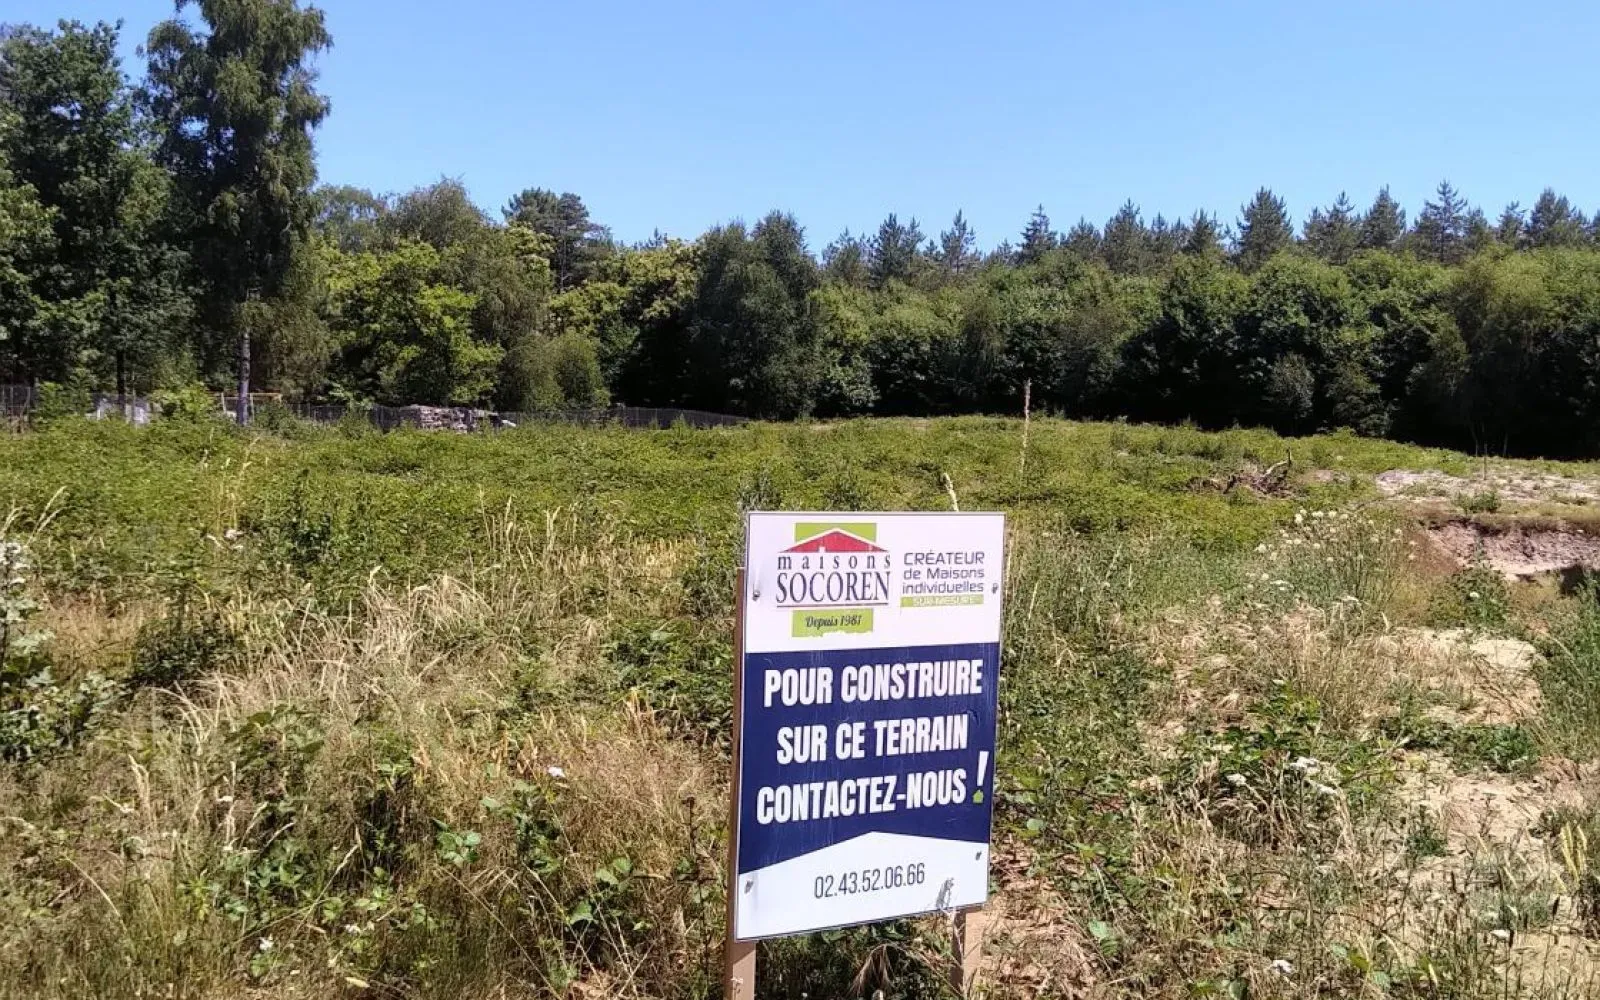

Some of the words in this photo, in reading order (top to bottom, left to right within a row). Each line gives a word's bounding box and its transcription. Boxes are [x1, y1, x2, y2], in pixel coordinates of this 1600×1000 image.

[777, 553, 891, 570] maisons
[903, 549, 985, 566] CRÉATEUR
[903, 568, 921, 581] de
[926, 566, 985, 580] Maisons
[775, 571, 891, 604] SOCOREN
[902, 580, 985, 595] individuelles
[805, 614, 838, 630] Depuis
[763, 666, 834, 708] POUR
[840, 659, 984, 704] CONSTRUIRE
[776, 725, 828, 765] SUR
[835, 721, 867, 761] CE
[873, 713, 969, 757] TERRAIN
[756, 768, 967, 825] CONTACTEZ-NOUS
[813, 862, 926, 900] 02.43.52.06.66
